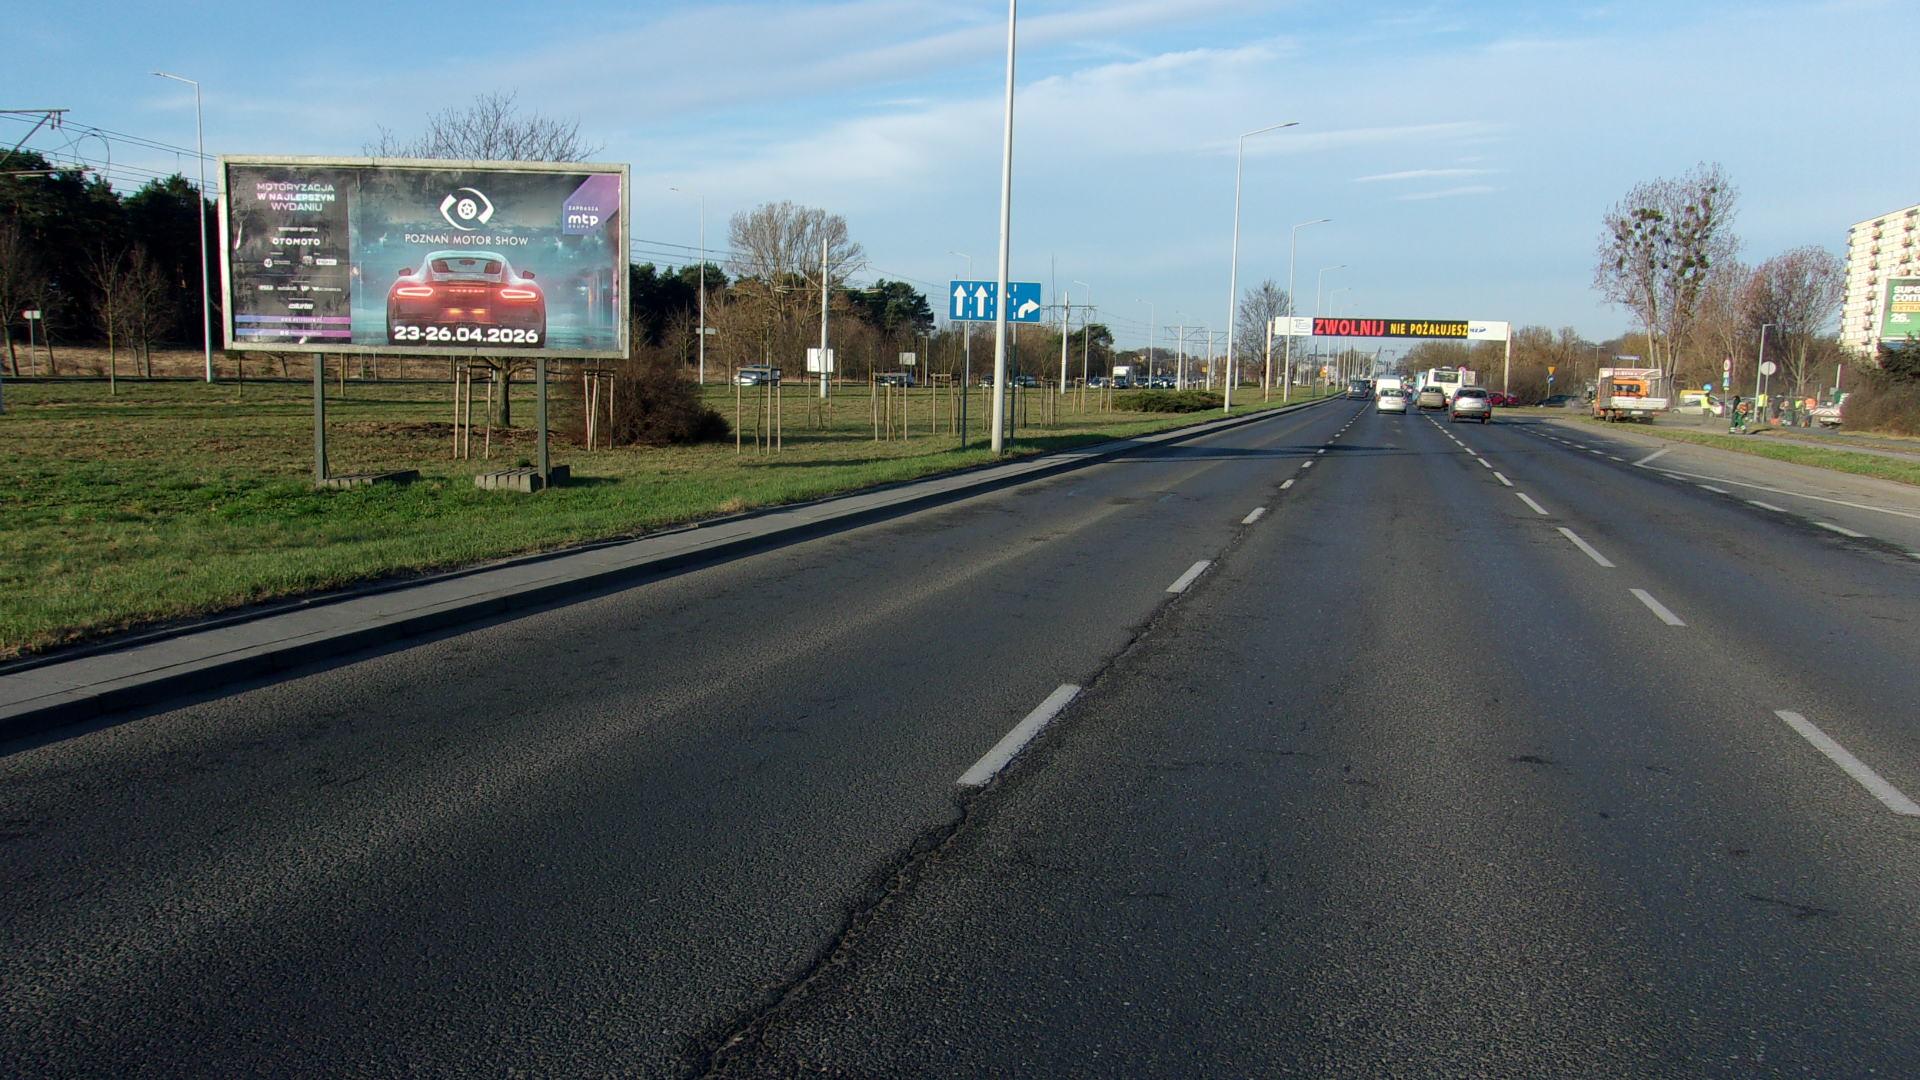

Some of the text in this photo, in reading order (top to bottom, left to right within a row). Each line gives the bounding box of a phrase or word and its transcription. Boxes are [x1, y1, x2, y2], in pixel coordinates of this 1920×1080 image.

[256, 183, 335, 192] MOTORYZACJA
[269, 193, 336, 201] NAJLEPSZYM
[271, 202, 323, 212] WYDANIU
[568, 213, 599, 226] mtp
[272, 237, 321, 246] OTOMOTO
[404, 232, 529, 246] POZNAŃ MOTOR SHOW
[1314, 319, 1385, 336] ZWOLNIJ
[1390, 323, 1406, 335] NIE
[1410, 321, 1468, 336] POŻAŁUJESZ
[394, 325, 539, 344] 23-26.04.2026
